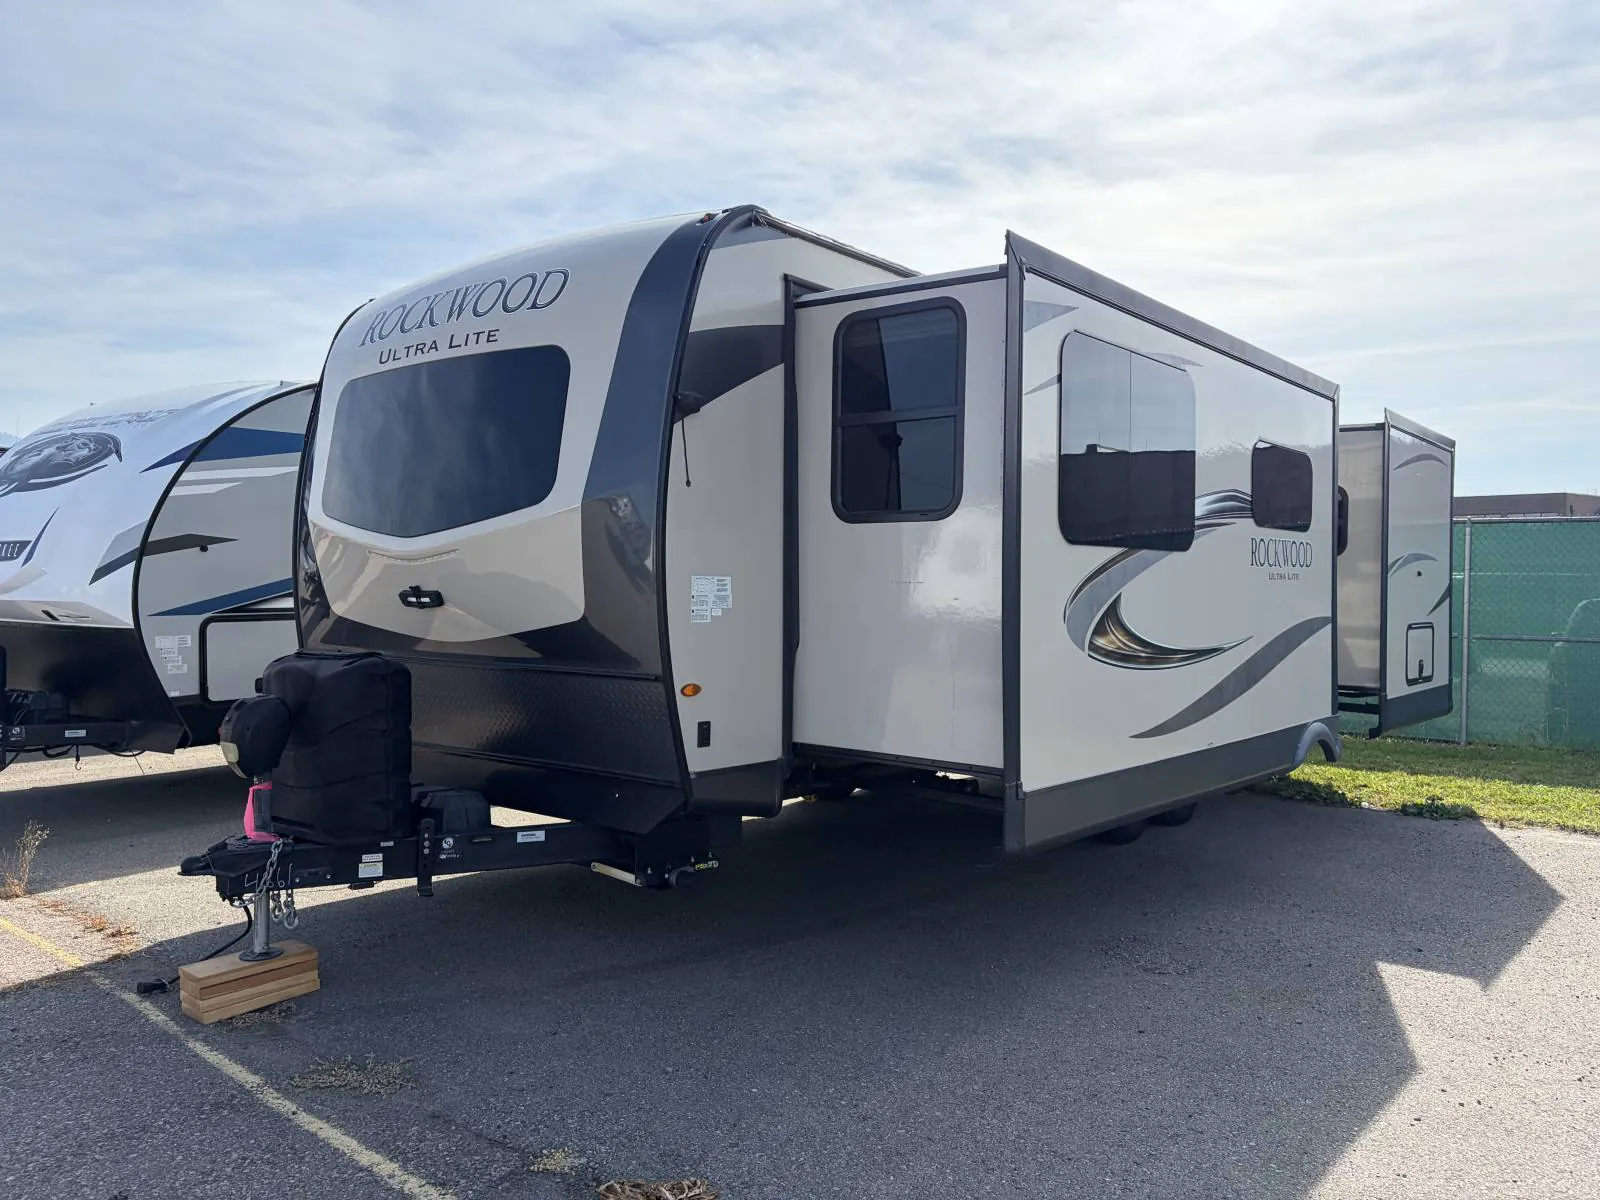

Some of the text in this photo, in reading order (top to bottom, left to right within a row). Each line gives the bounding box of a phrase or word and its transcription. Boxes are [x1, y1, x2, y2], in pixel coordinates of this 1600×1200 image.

[358, 268, 570, 347] ROCKWOOD
[379, 328, 500, 365] ULTRA LITE
[1250, 537, 1313, 568] ROCKWOOD
[1268, 572, 1301, 581] ULTRA LITE
